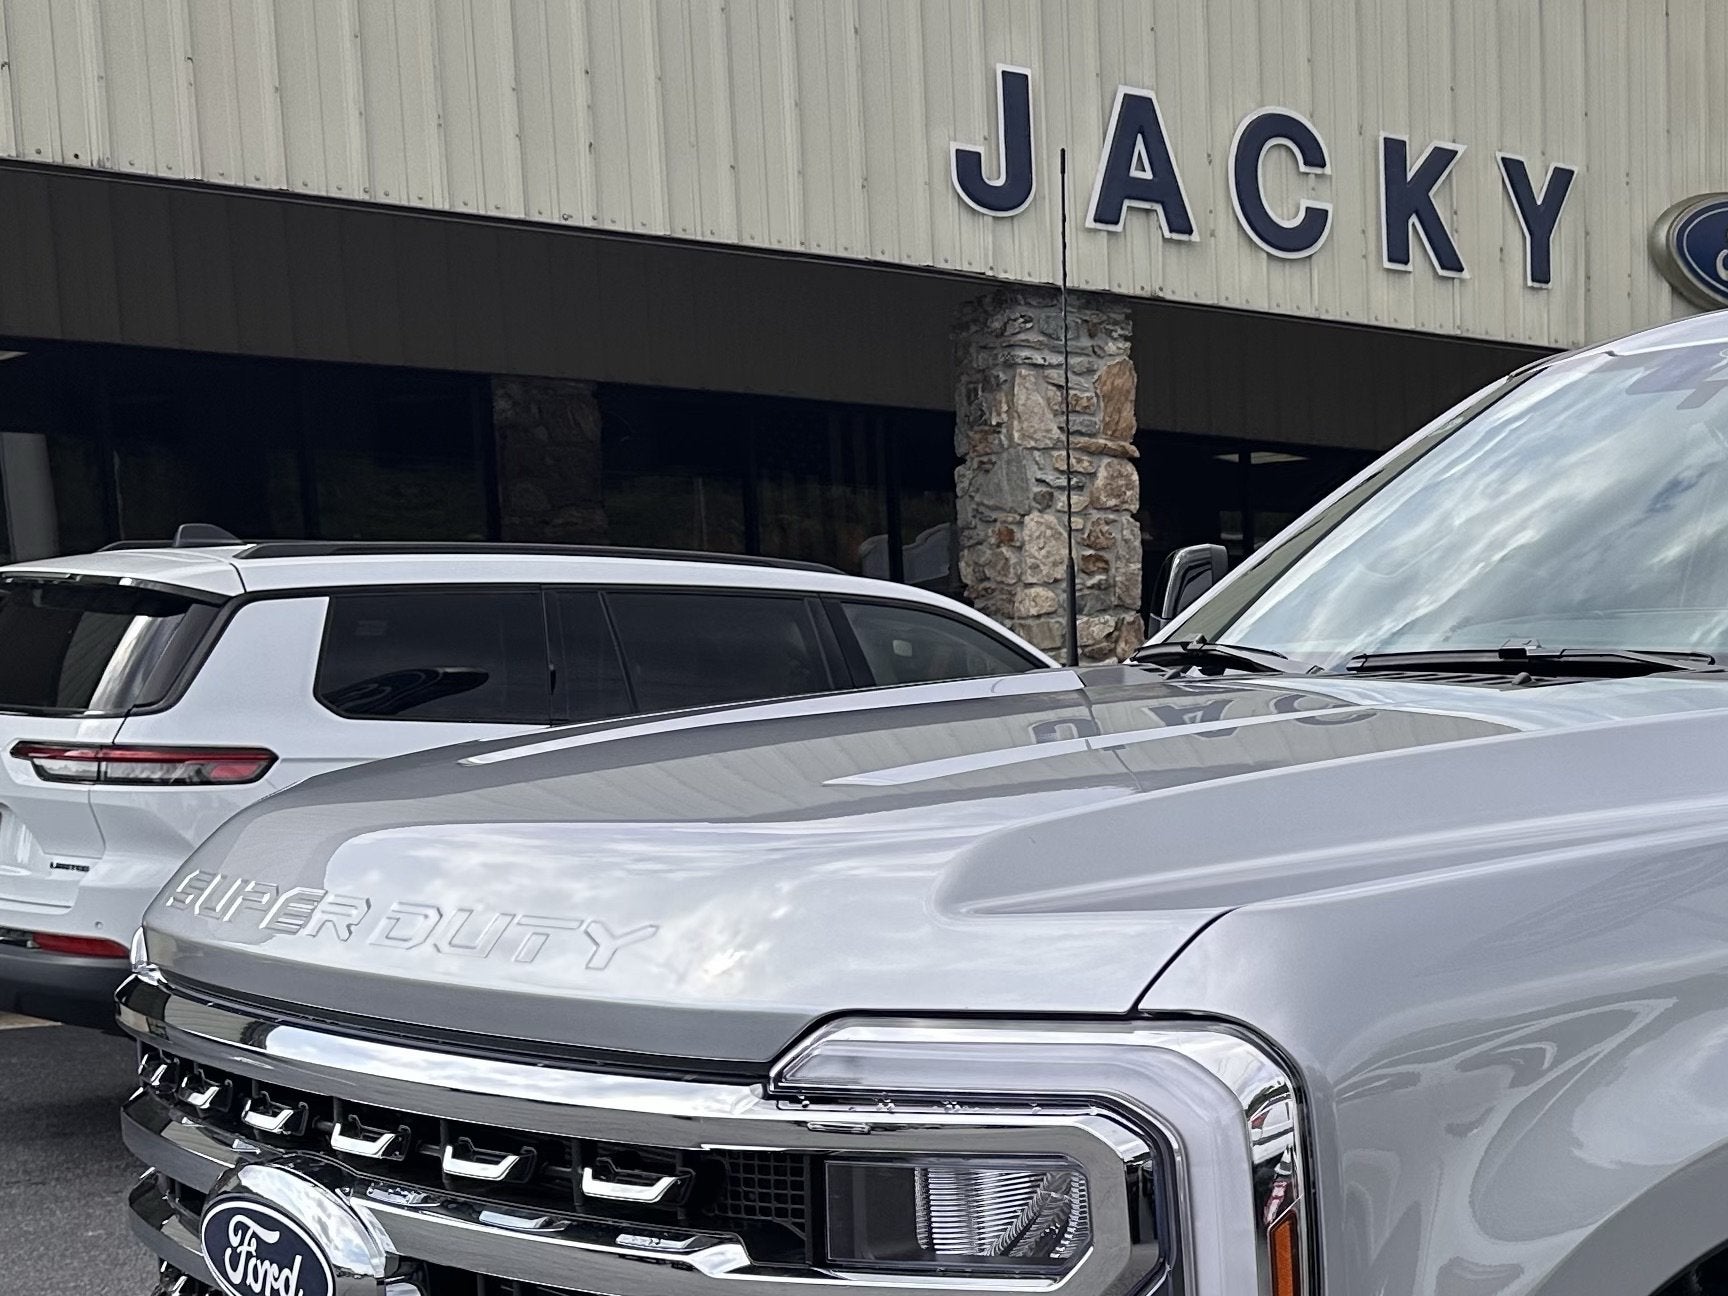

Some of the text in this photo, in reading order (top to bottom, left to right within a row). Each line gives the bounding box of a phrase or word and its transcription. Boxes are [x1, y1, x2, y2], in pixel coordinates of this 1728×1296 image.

[949, 62, 1579, 289] JACKY
[165, 870, 660, 971] SUPER DUTY
